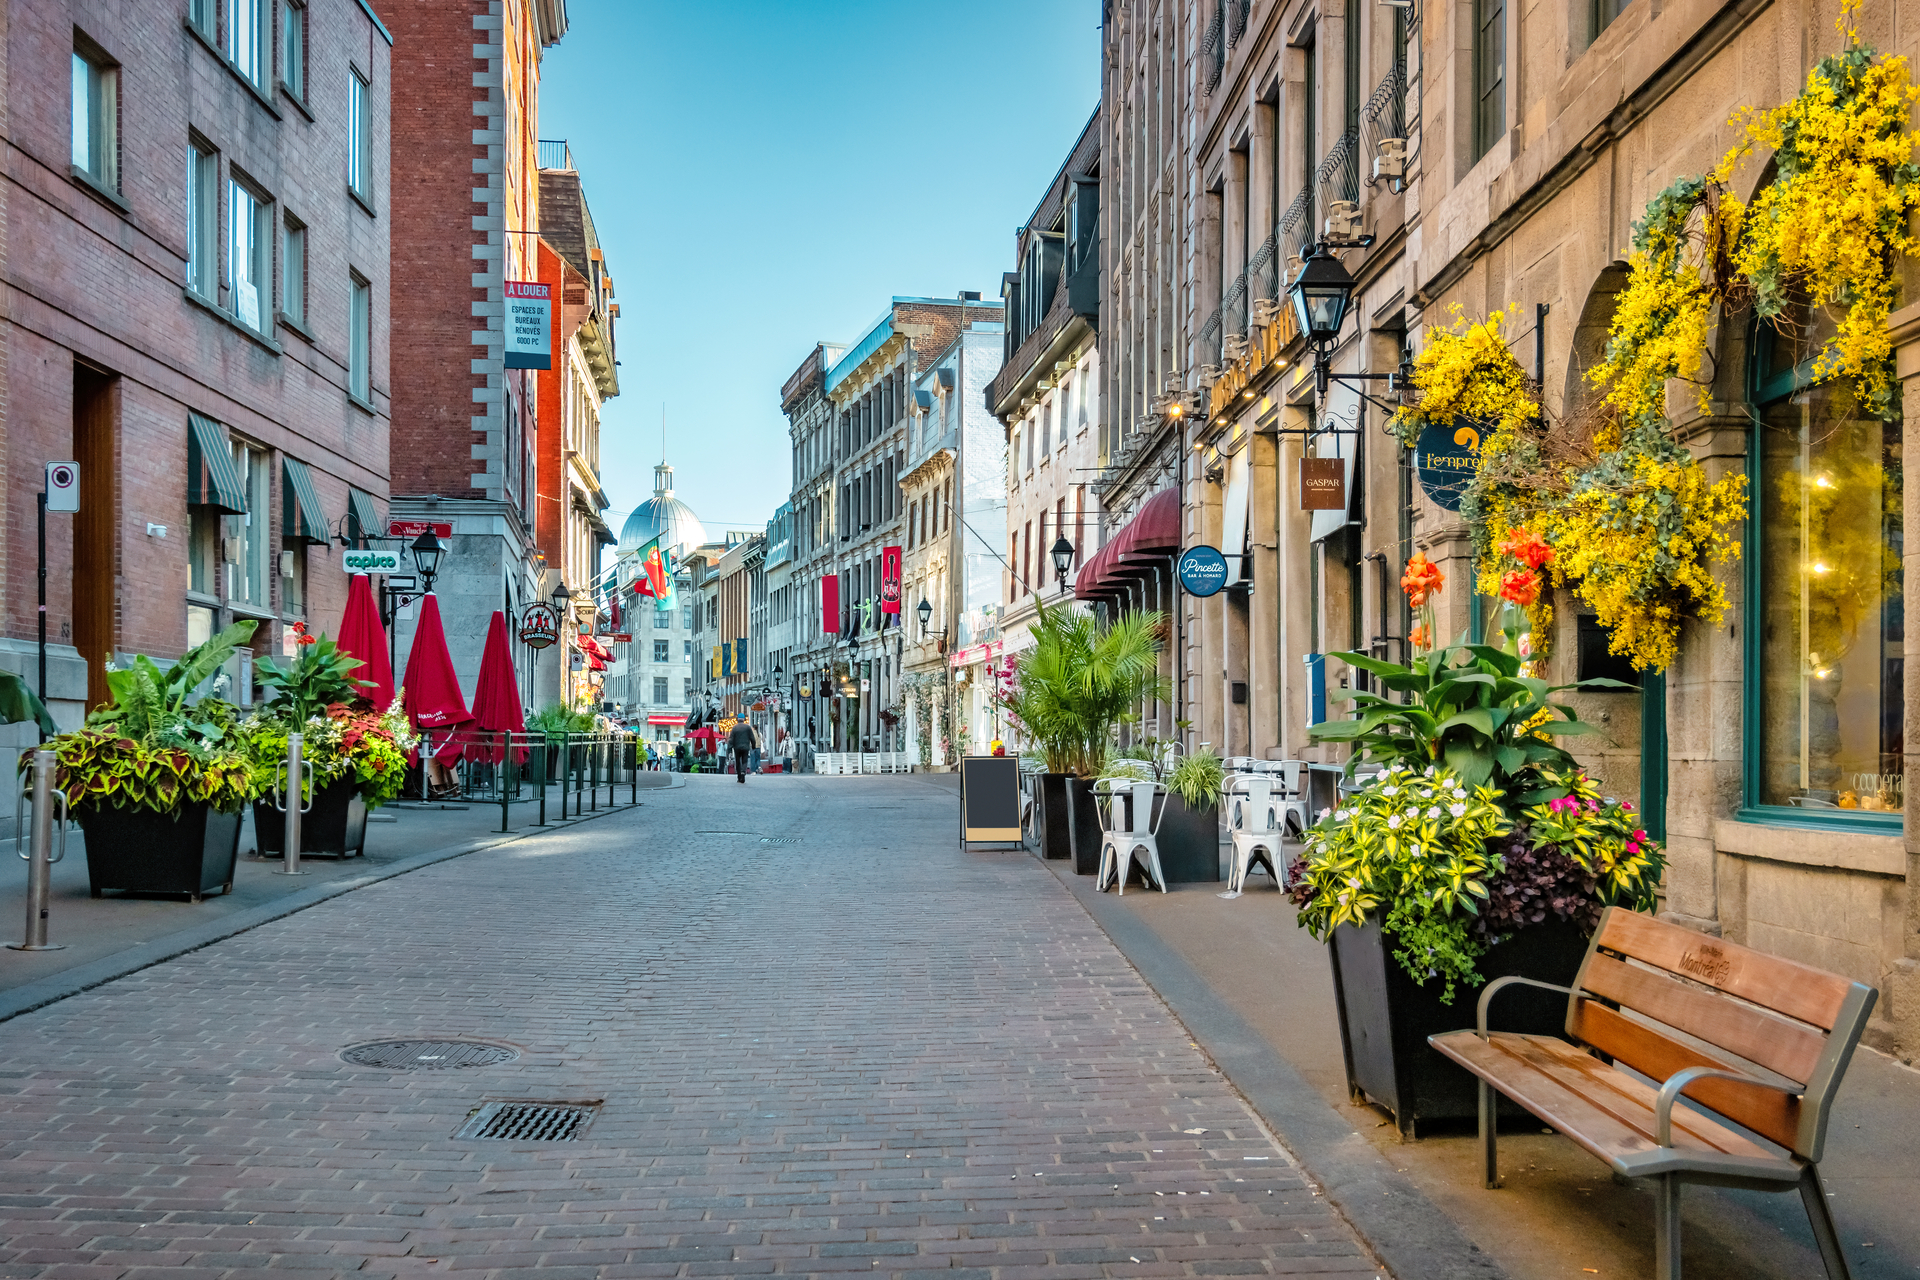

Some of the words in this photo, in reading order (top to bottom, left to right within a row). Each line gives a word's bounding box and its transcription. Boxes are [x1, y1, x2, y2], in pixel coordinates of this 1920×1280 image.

[508, 282, 515, 295] À
[518, 284, 548, 296] LOUER
[511, 305, 536, 315] ESPACES
[536, 307, 545, 315] DE
[515, 316, 541, 325] BUREAUX
[515, 325, 541, 336] RÉNOVÉS
[516, 336, 531, 345] 6000
[531, 338, 540, 346] PC
[1306, 478, 1340, 487] GASPAR
[345, 552, 396, 570] capisco
[1181, 558, 1225, 573] Pincette
[523, 632, 556, 641] BRASSEURS
[1678, 951, 1719, 980] Montréal
